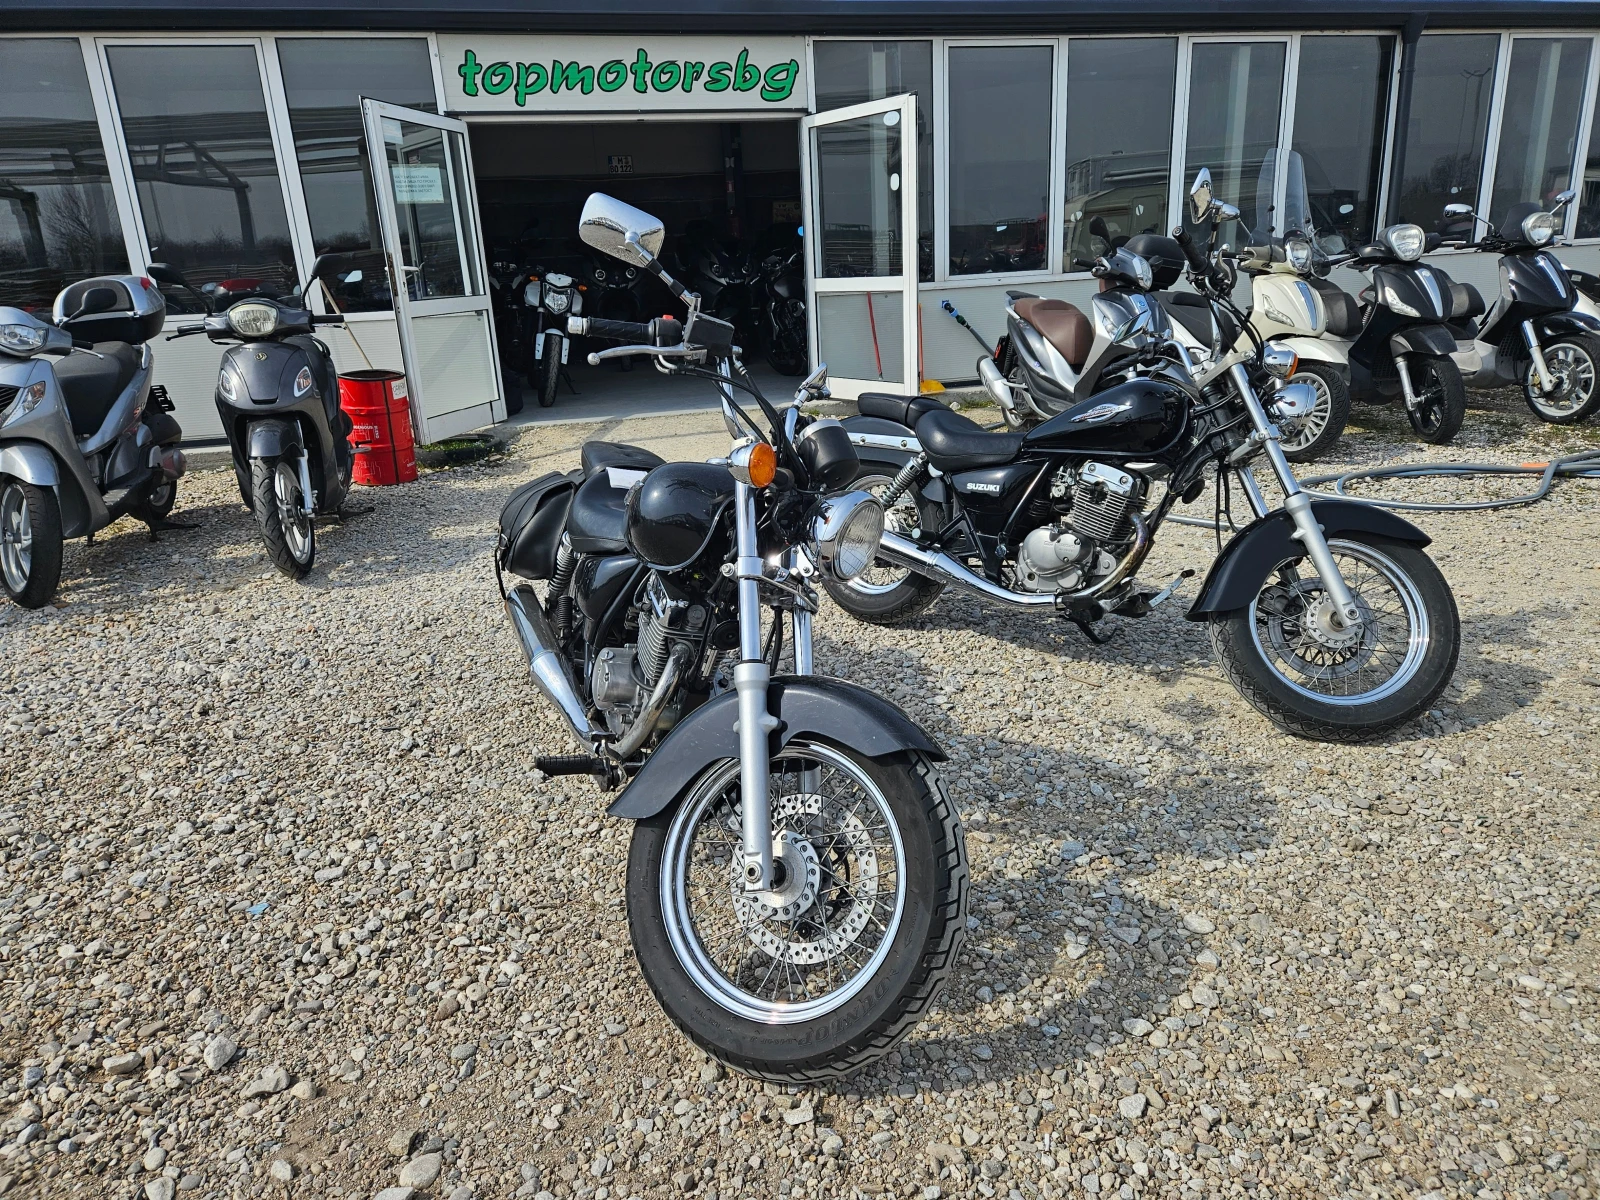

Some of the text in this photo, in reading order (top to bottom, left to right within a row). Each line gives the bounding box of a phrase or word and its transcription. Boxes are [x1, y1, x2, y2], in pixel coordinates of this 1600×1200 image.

[458, 47, 799, 107] topmotorsbg
[966, 482, 1000, 492] SUZUKI
[797, 978, 890, 1047] DUNLOP
